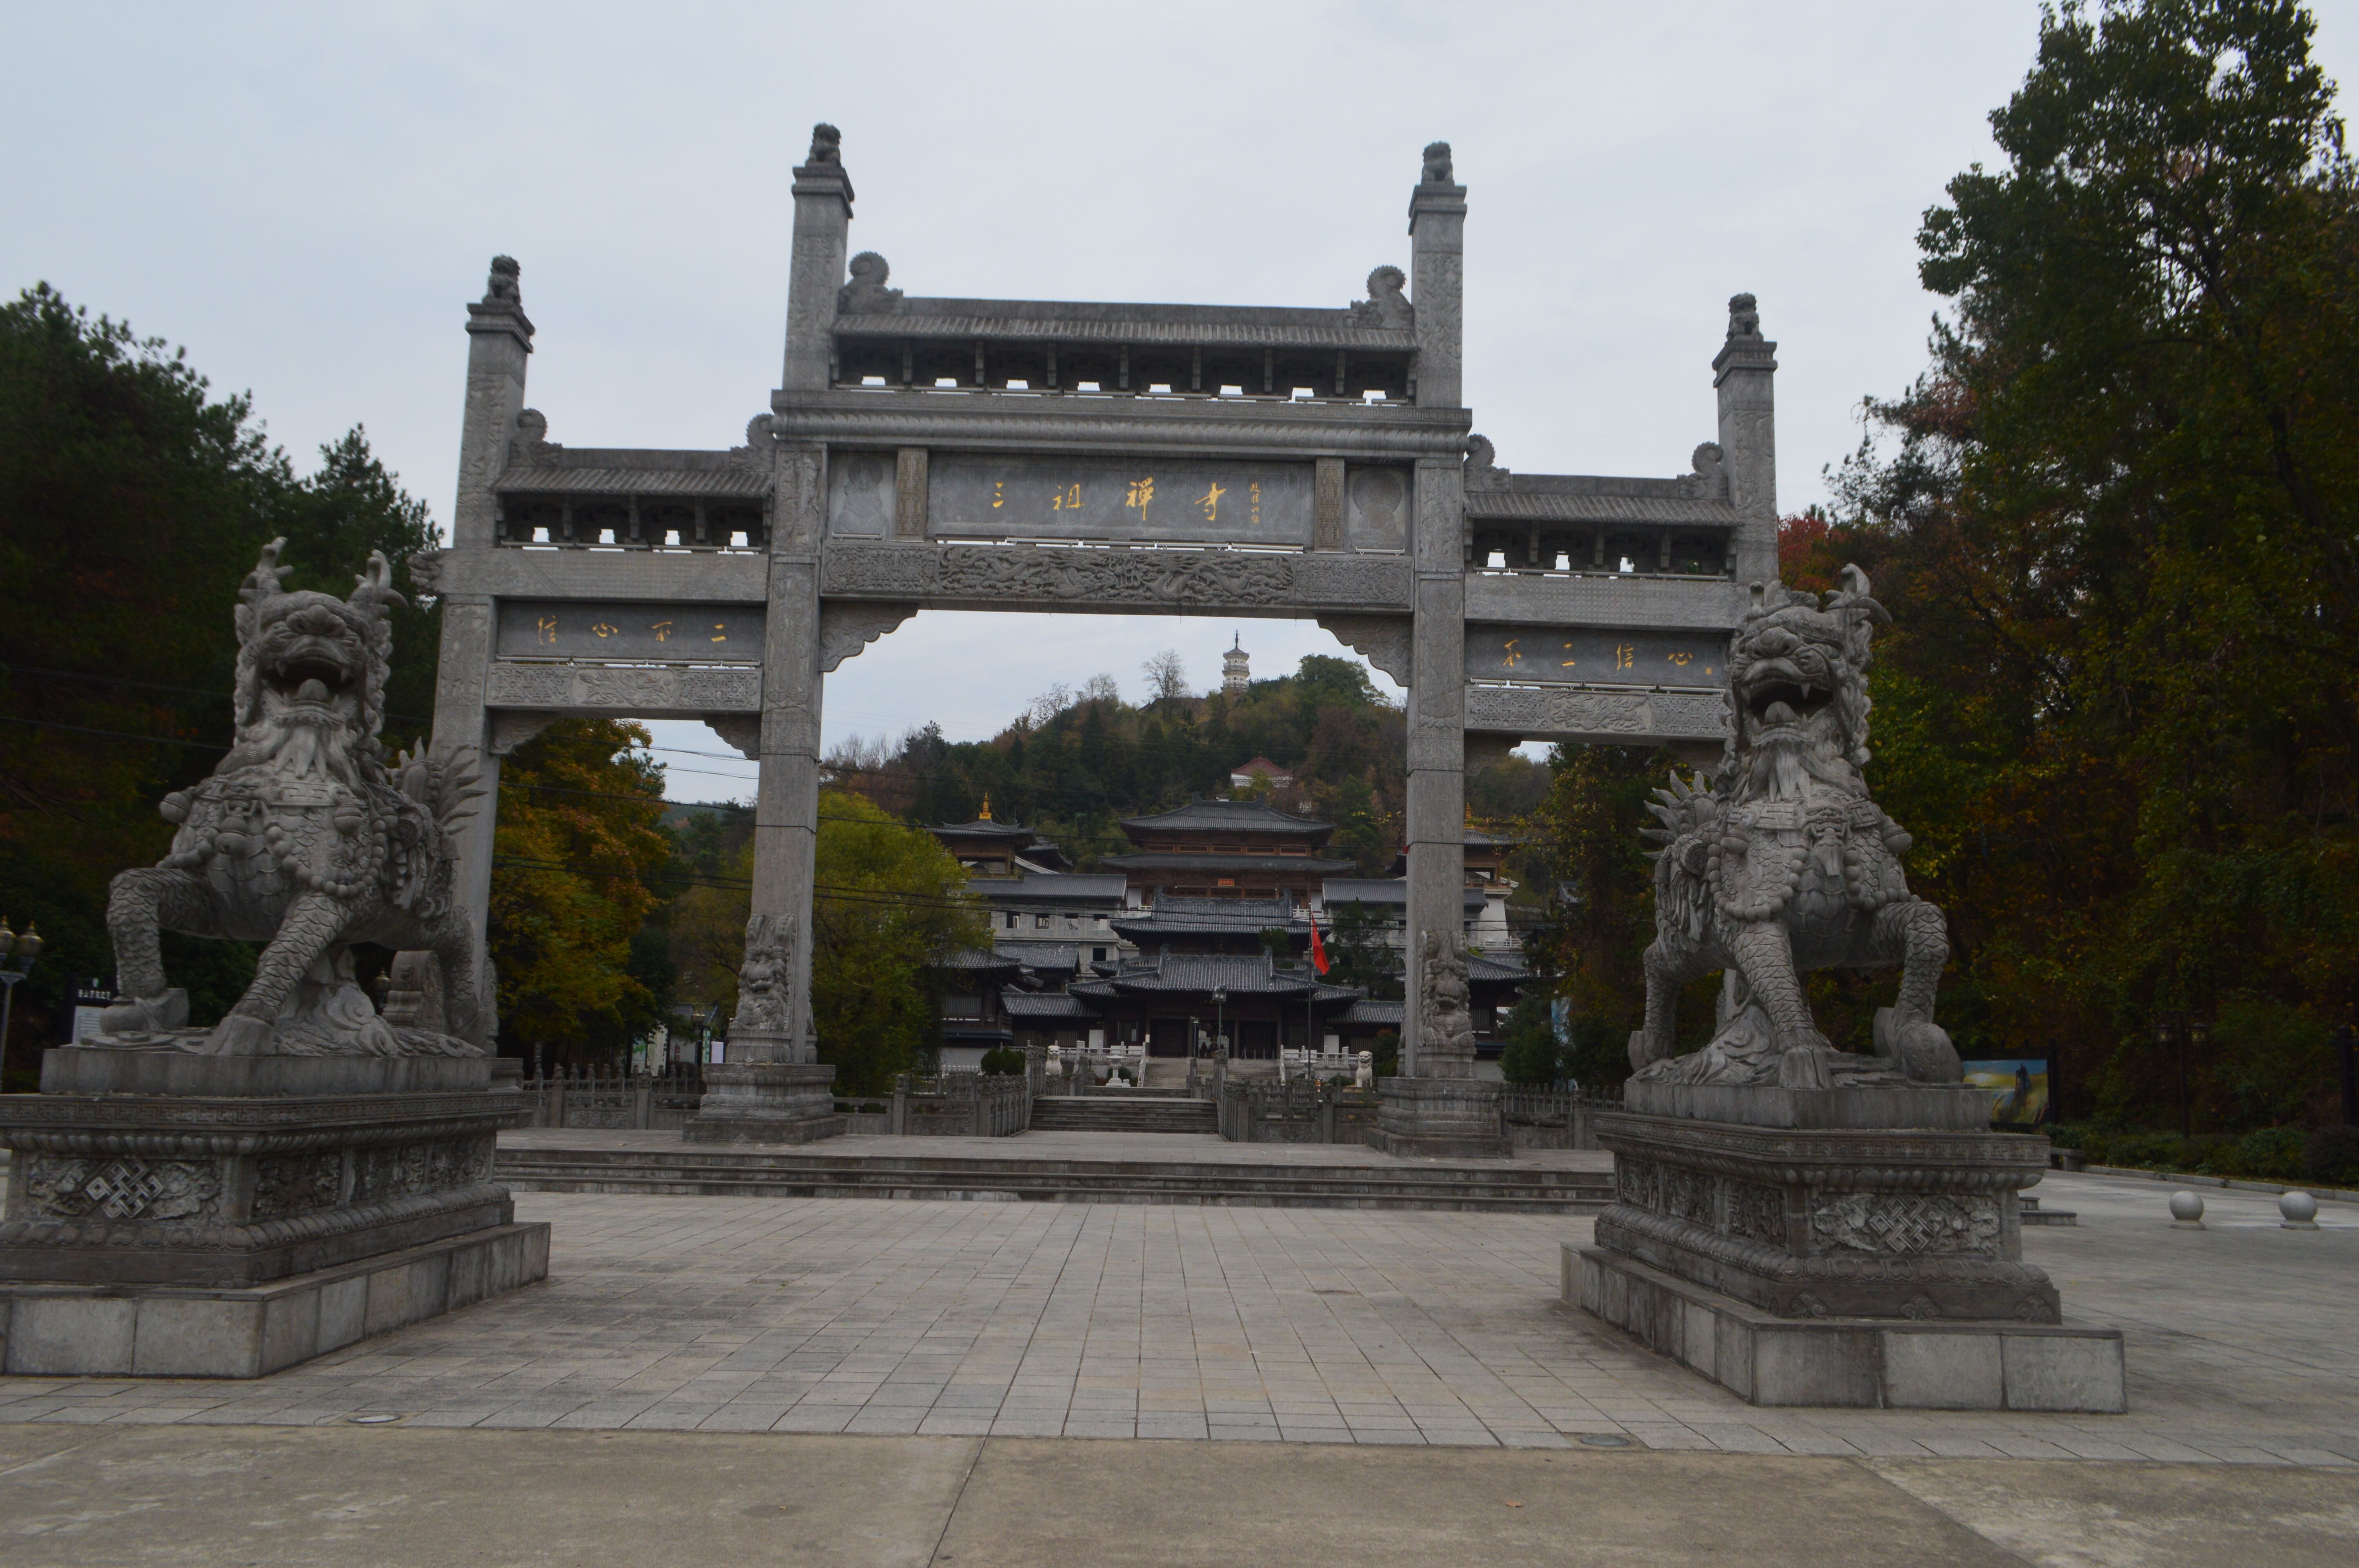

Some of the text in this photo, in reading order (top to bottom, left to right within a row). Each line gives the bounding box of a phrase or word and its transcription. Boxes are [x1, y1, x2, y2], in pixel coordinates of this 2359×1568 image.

[538, 614, 728, 645] 信心不二
[1502, 639, 1694, 671] 不二信心
